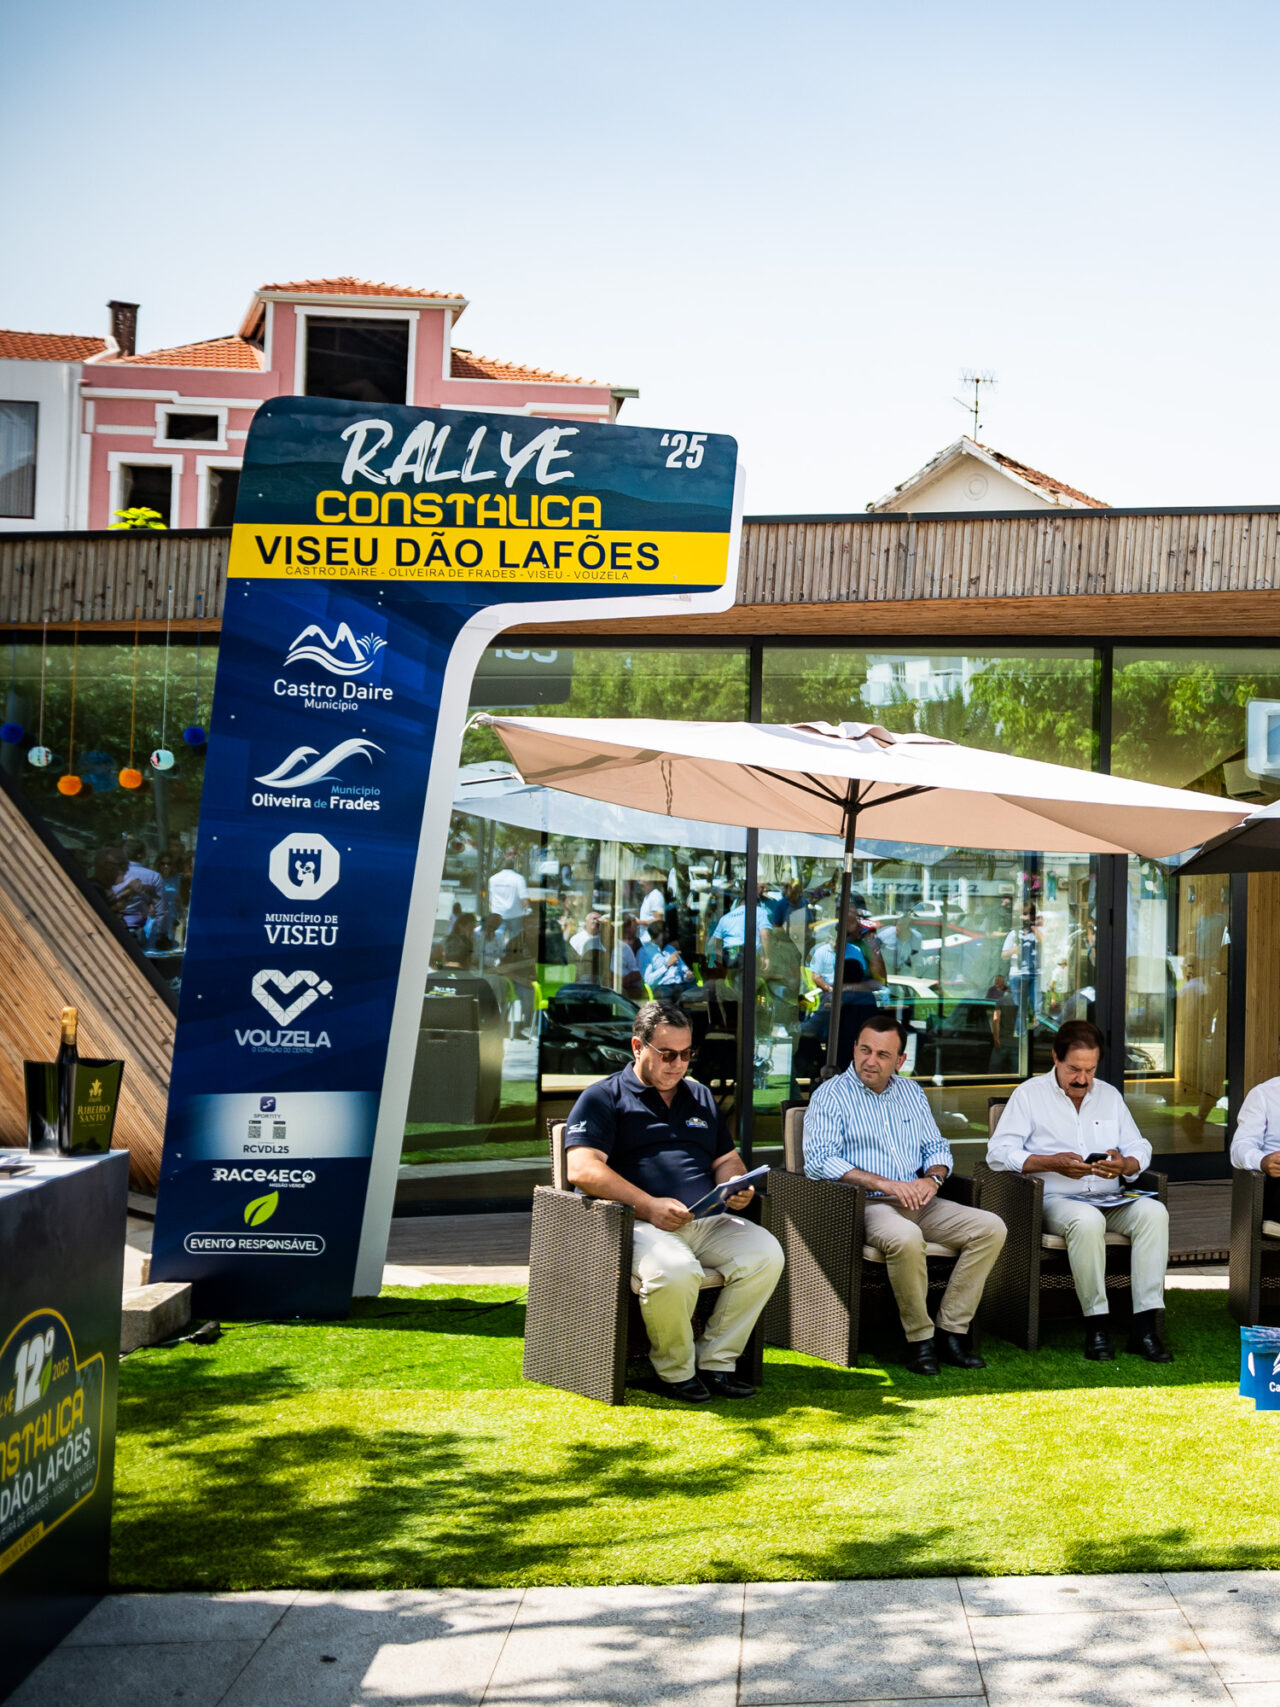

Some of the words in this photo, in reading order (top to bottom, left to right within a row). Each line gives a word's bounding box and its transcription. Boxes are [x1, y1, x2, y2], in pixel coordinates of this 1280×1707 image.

[340, 419, 580, 488] RALLYE
[660, 434, 708, 470] '25
[316, 490, 602, 527] CONSTALICA
[255, 535, 379, 566] VISEU
[395, 532, 484, 569] DÃO
[500, 534, 660, 571] LAFÕES
[286, 566, 337, 577] CASTRO
[340, 567, 377, 577] DAIRE
[389, 567, 445, 578] OLIVEIRA
[449, 569, 464, 578] DE
[468, 569, 516, 579] FRADES
[527, 570, 563, 579] VISEU
[574, 570, 629, 580] VOUZELA
[274, 678, 337, 698] Castro
[343, 681, 394, 700] Daire
[304, 698, 359, 712] Município
[252, 793, 312, 808] Oliveira
[313, 799, 328, 808] de
[329, 796, 381, 811] Frades
[265, 911, 321, 924] MUNICÍPIO
[324, 914, 338, 924] DE
[264, 924, 339, 946] VISEU
[235, 1029, 331, 1048] VOUZELA
[77, 1105, 110, 1115] RIBEIRO
[79, 1114, 106, 1123] SANTO
[243, 1144, 289, 1154] RCVDL25
[190, 1238, 236, 1249] EVENTO
[238, 1237, 319, 1251] RESPONSÁVEL
[0, 1471, 33, 1525] DÃO
[37, 1427, 91, 1494] LAFÕES
